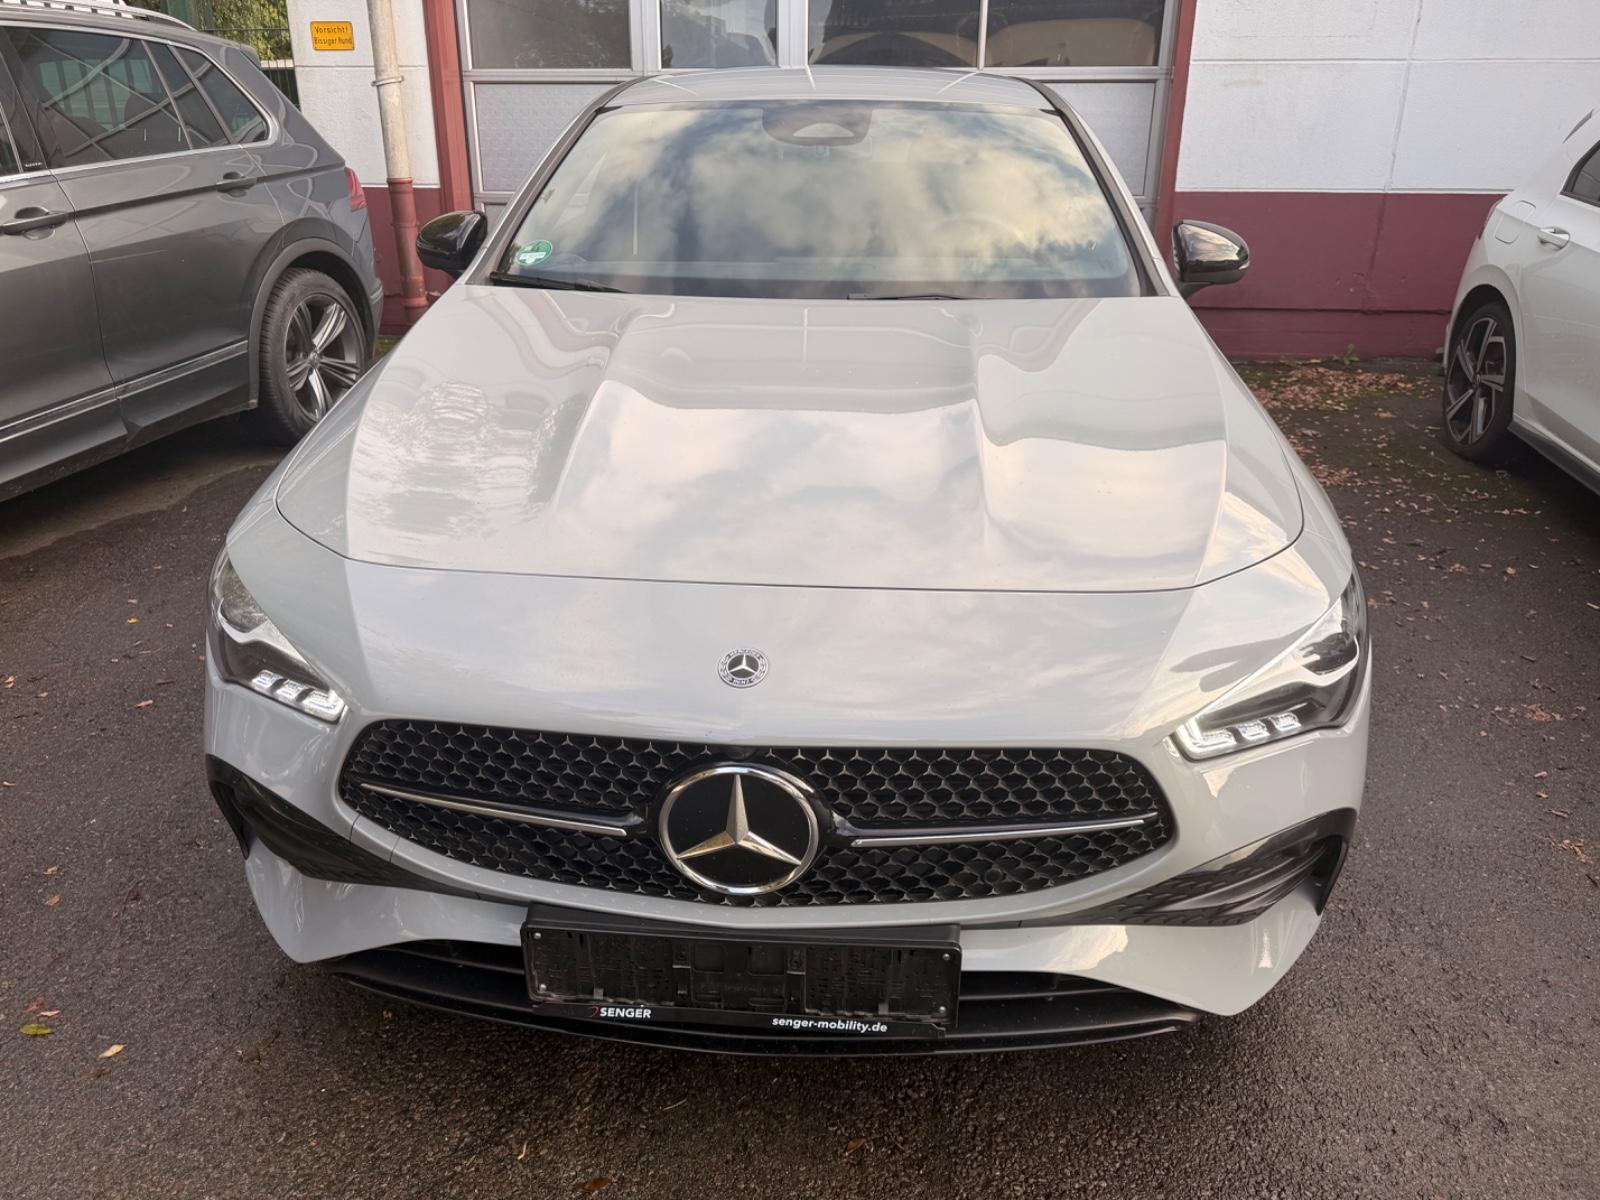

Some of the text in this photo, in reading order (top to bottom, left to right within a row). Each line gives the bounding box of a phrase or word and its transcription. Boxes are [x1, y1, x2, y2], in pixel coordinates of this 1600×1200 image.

[314, 26, 348, 34] Vorsicht!
[600, 1007, 652, 1018] SENGER
[772, 1018, 888, 1033] senger-mobility.de
